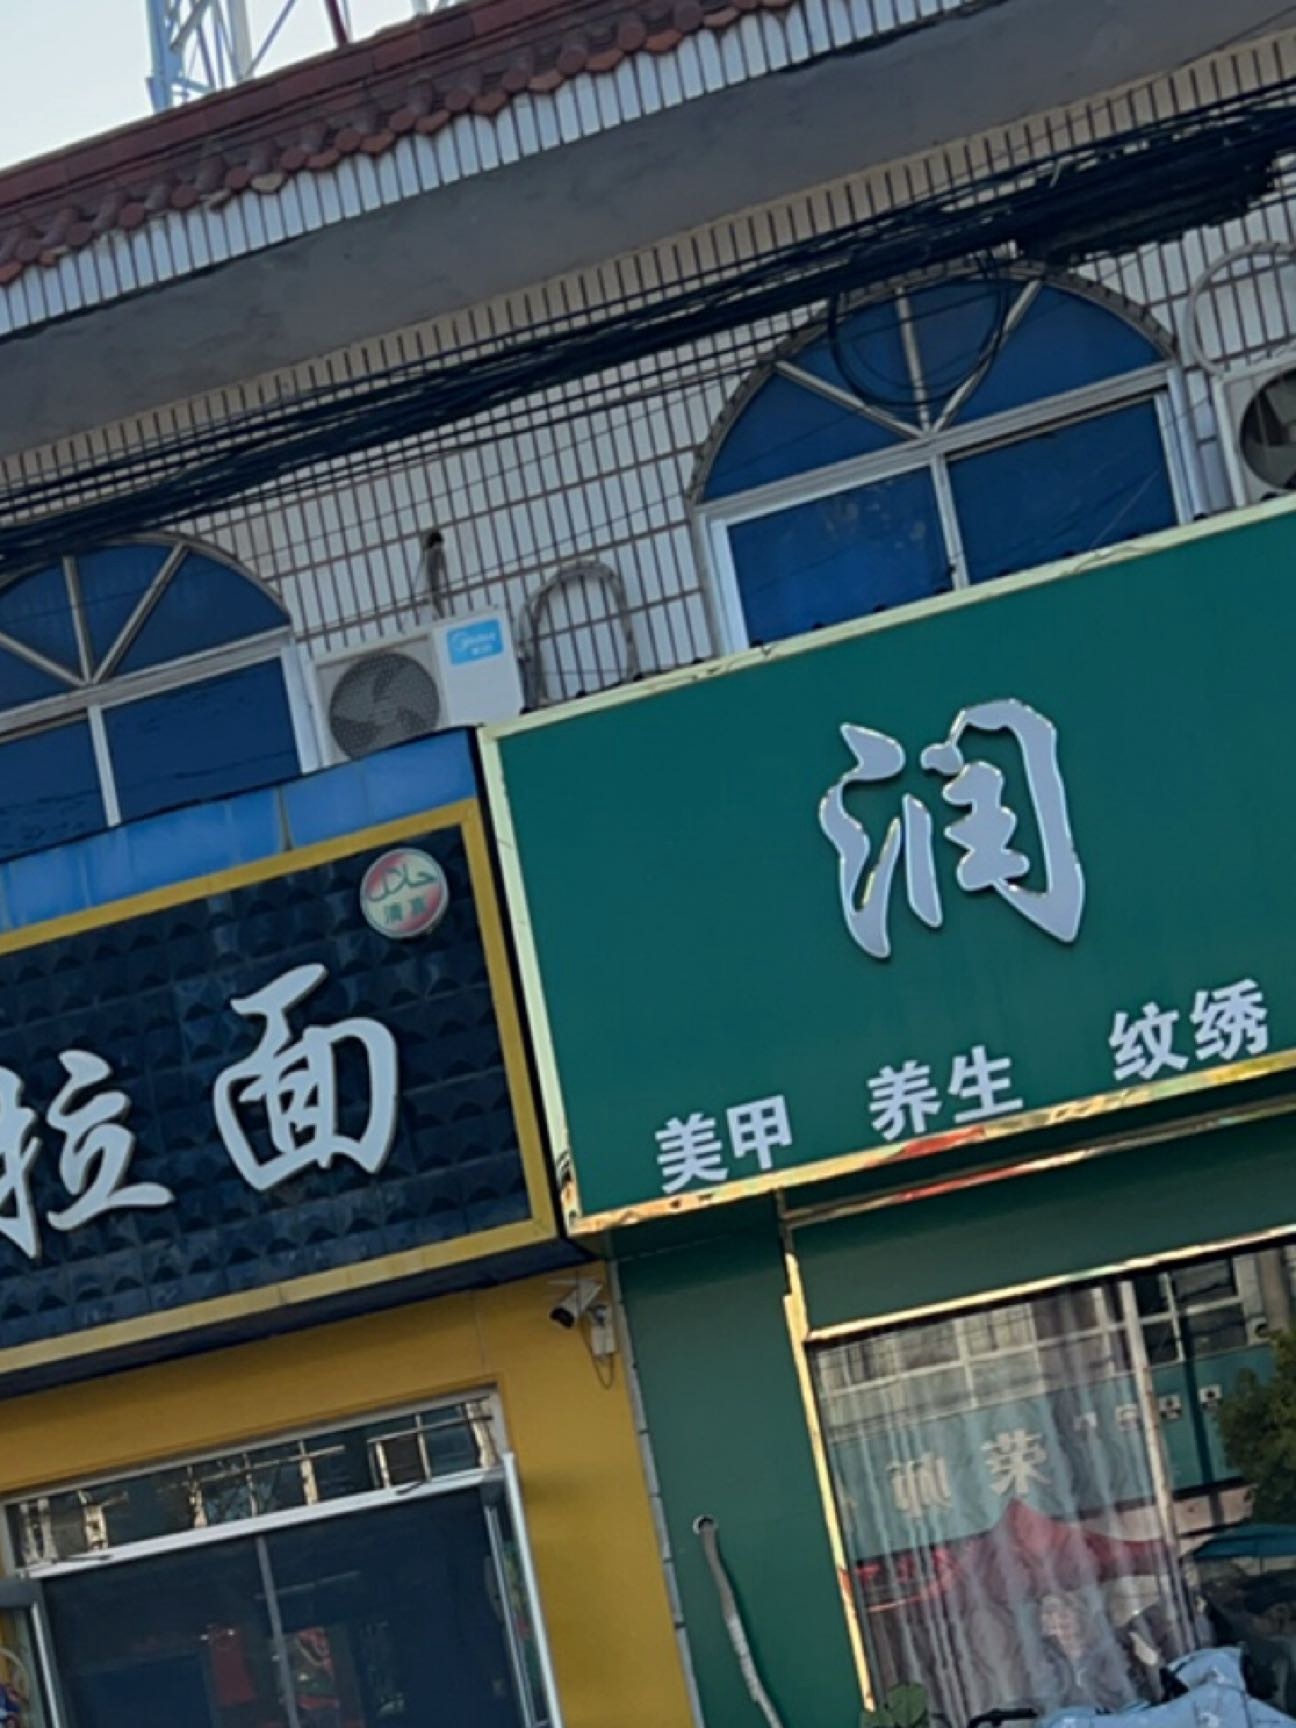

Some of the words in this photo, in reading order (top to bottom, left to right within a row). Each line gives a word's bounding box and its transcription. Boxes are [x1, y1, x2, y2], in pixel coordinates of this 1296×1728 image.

[819, 698, 1084, 958] 润
[655, 1095, 793, 1194] 美甲
[867, 1045, 1023, 1141] 养生
[1109, 979, 1270, 1081] 纹绣
